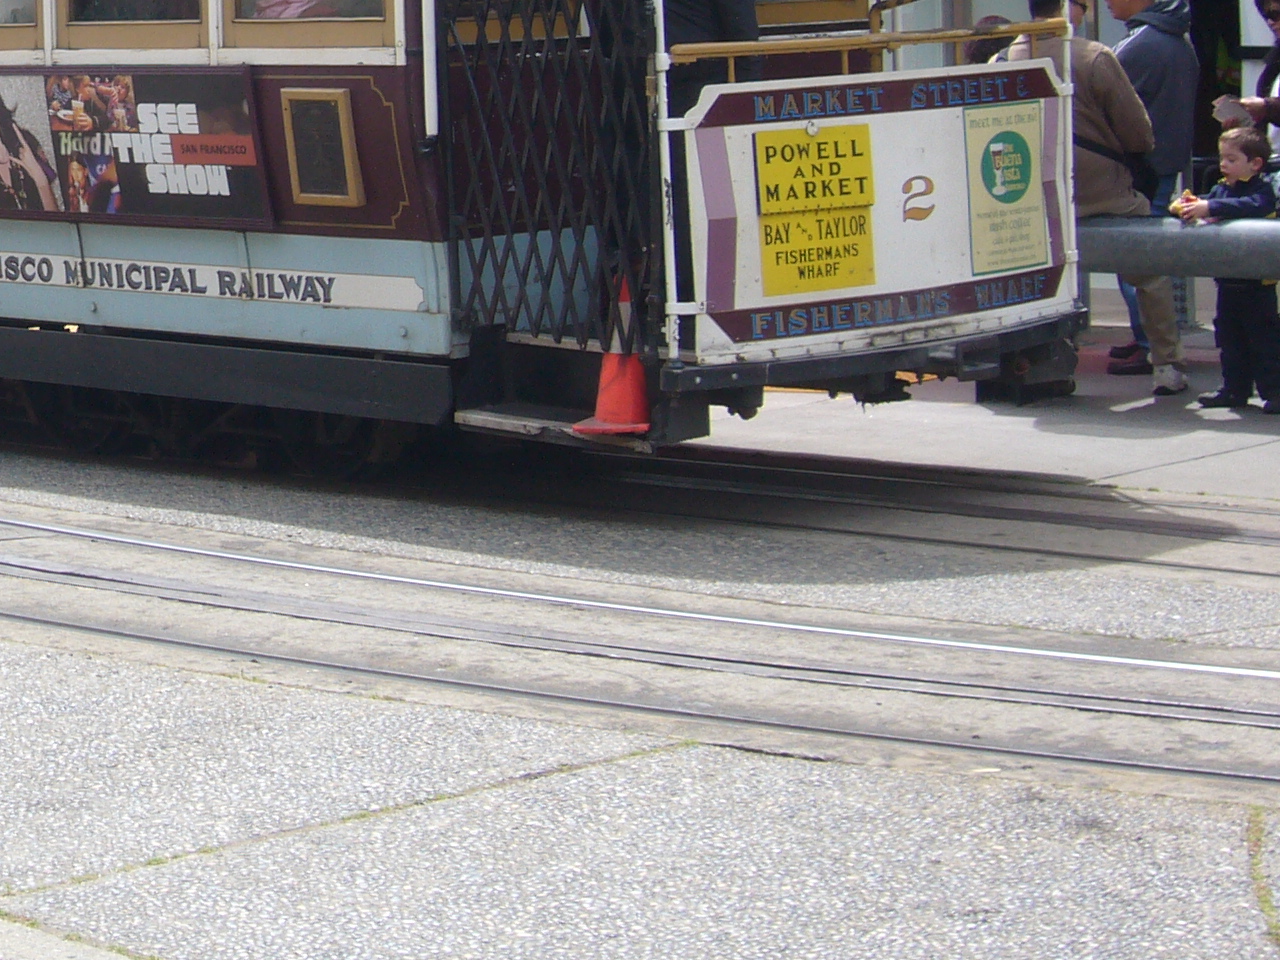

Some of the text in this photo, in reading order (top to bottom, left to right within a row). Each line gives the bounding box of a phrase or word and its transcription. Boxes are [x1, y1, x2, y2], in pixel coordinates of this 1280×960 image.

[754, 87, 884, 122] MARKET
[910, 77, 1008, 110] STREET
[136, 102, 200, 135] SEE
[111, 133, 175, 164] THE
[180, 143, 248, 156] SAN FRANCISCO
[764, 139, 864, 164] POWELL
[145, 163, 231, 197] SHOW
[793, 161, 842, 179] AND
[765, 176, 869, 202] MARKET
[901, 175, 936, 223] 2
[763, 214, 867, 246] BAY AND TAYLOR
[775, 243, 860, 266] FISHERMANS
[63, 259, 208, 295] MUNICIPAL
[216, 269, 336, 304] RAILWAY
[797, 262, 841, 280] WHARF
[974, 273, 1047, 309] WHARF
